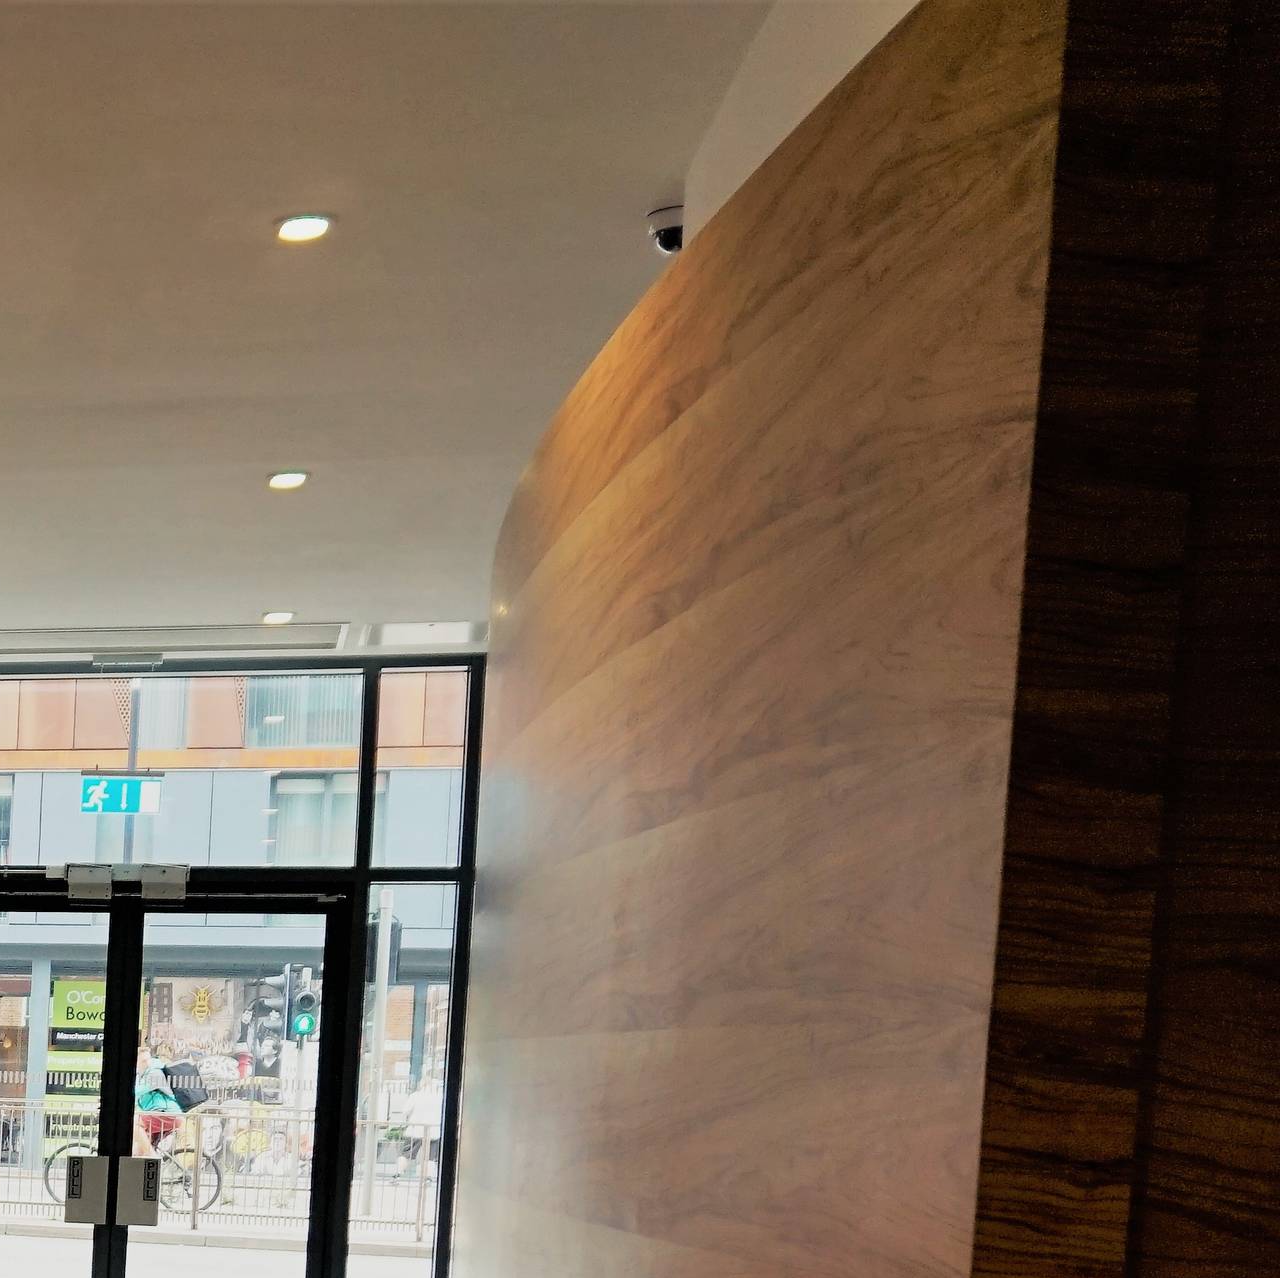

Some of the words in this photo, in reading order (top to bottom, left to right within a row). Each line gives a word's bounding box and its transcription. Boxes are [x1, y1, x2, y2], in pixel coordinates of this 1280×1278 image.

[56, 1032, 97, 1040] Manchester
[71, 1160, 80, 1196] PULL
[146, 1161, 155, 1199] PULL
